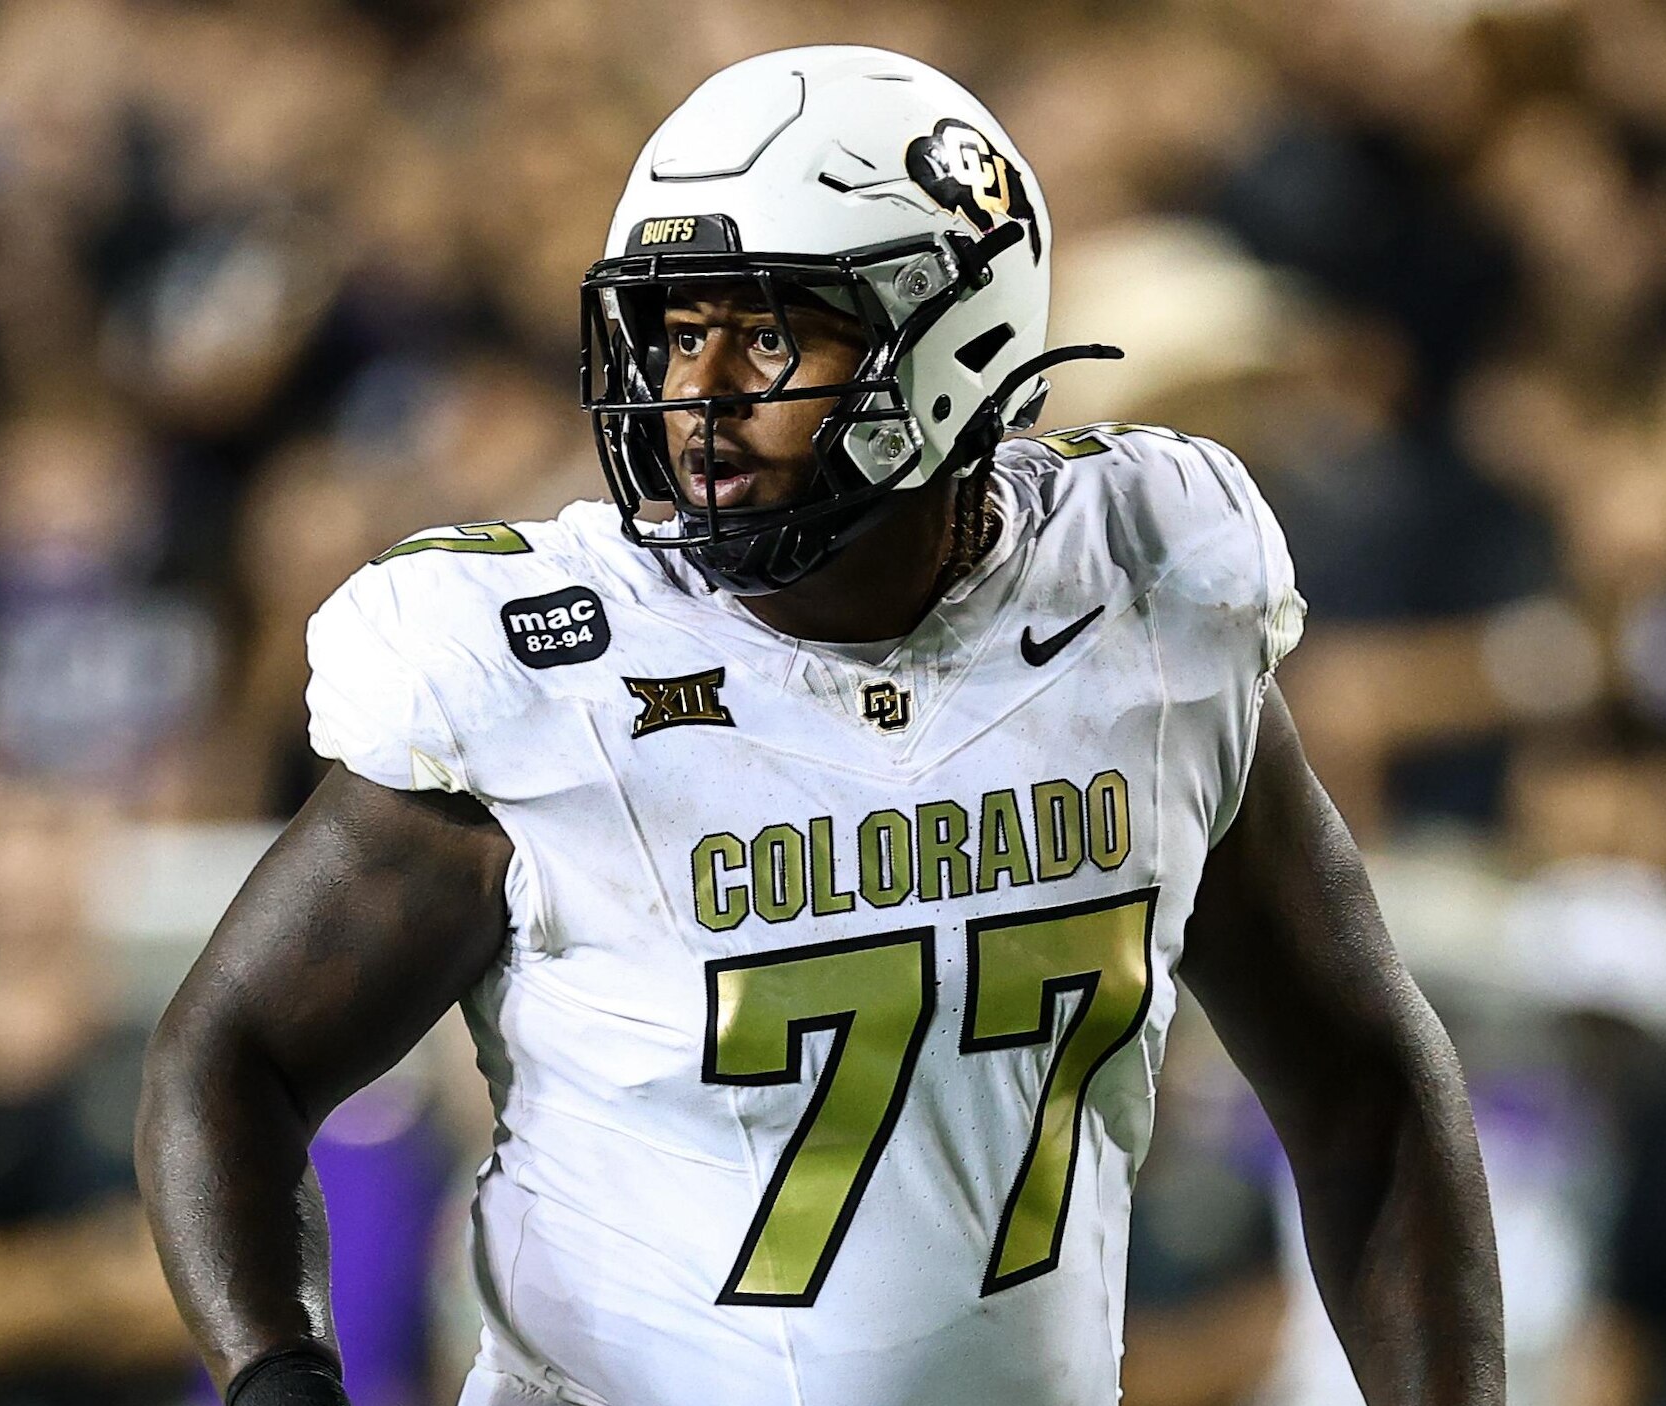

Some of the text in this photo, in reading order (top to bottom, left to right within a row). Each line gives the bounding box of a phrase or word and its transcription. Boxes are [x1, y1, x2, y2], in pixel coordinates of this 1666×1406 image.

[641, 218, 695, 245] BUFFS
[509, 599, 596, 633] mac
[526, 625, 594, 652] 82-94
[691, 769, 1132, 931] COLORADO
[702, 886, 1161, 1306] 77
